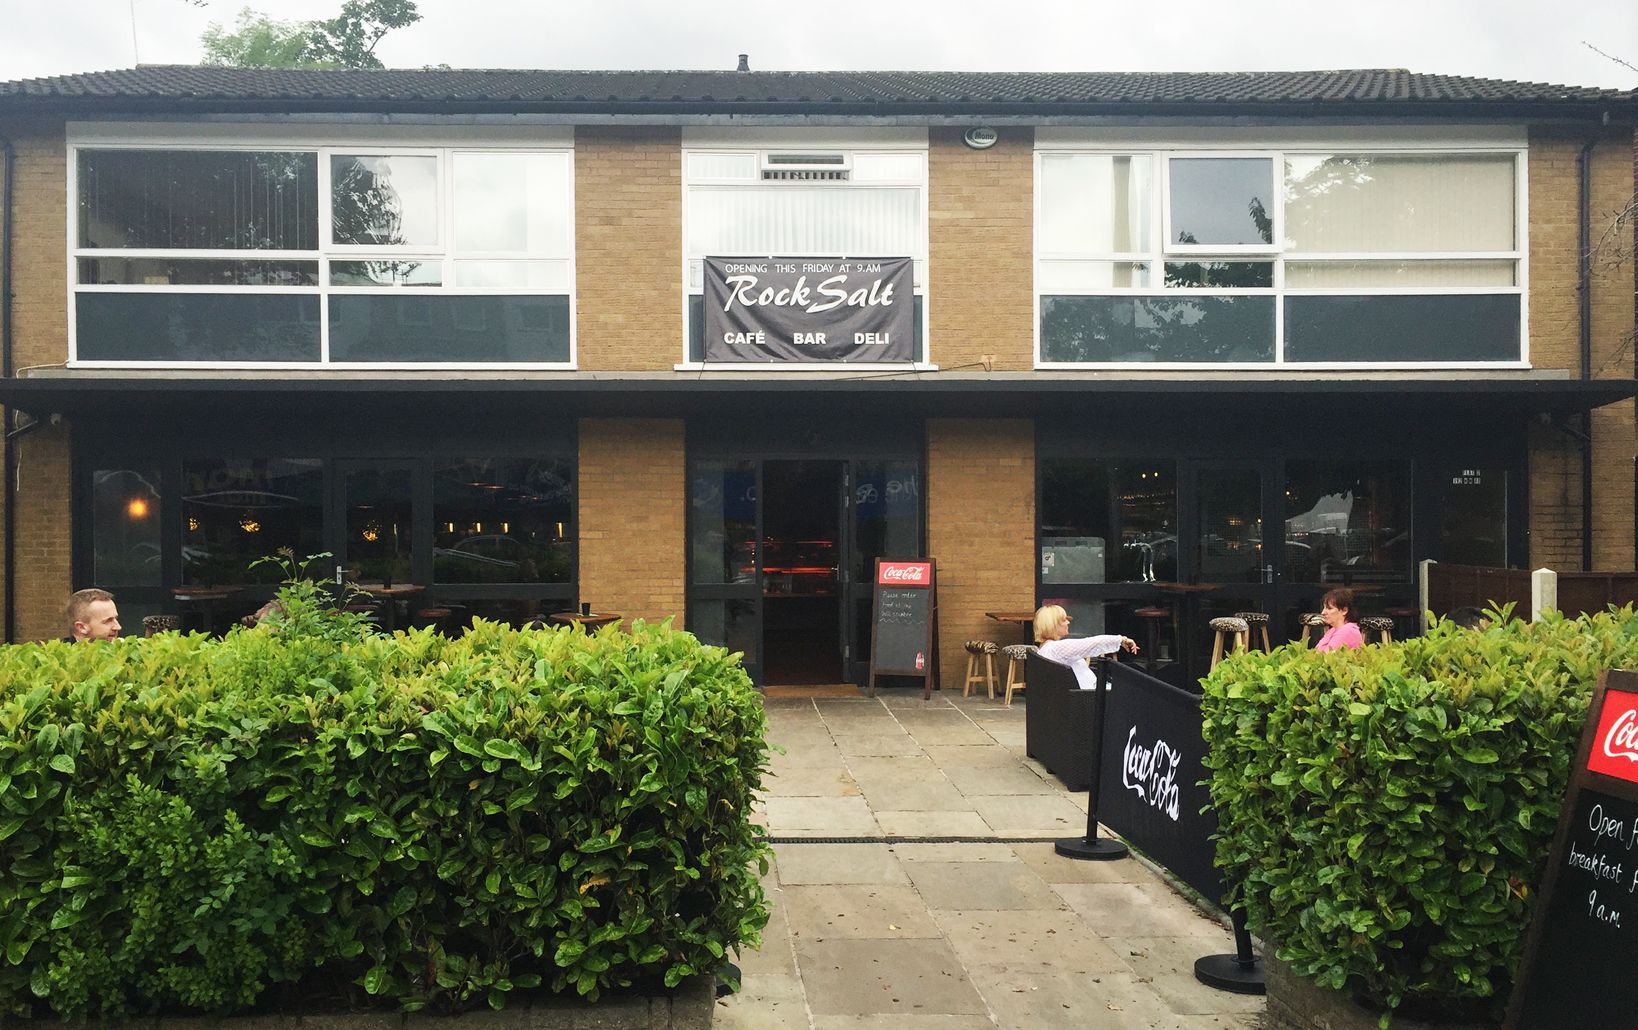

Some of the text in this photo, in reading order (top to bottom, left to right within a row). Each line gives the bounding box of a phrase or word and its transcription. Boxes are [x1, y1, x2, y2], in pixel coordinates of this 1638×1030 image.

[725, 263, 882, 273] OPENING THIS FRIDAY AT 9.AM
[723, 329, 890, 345] CAFÉ BAR DELI
[1589, 804, 1624, 847] Open
[1568, 841, 1623, 883] breakfast
